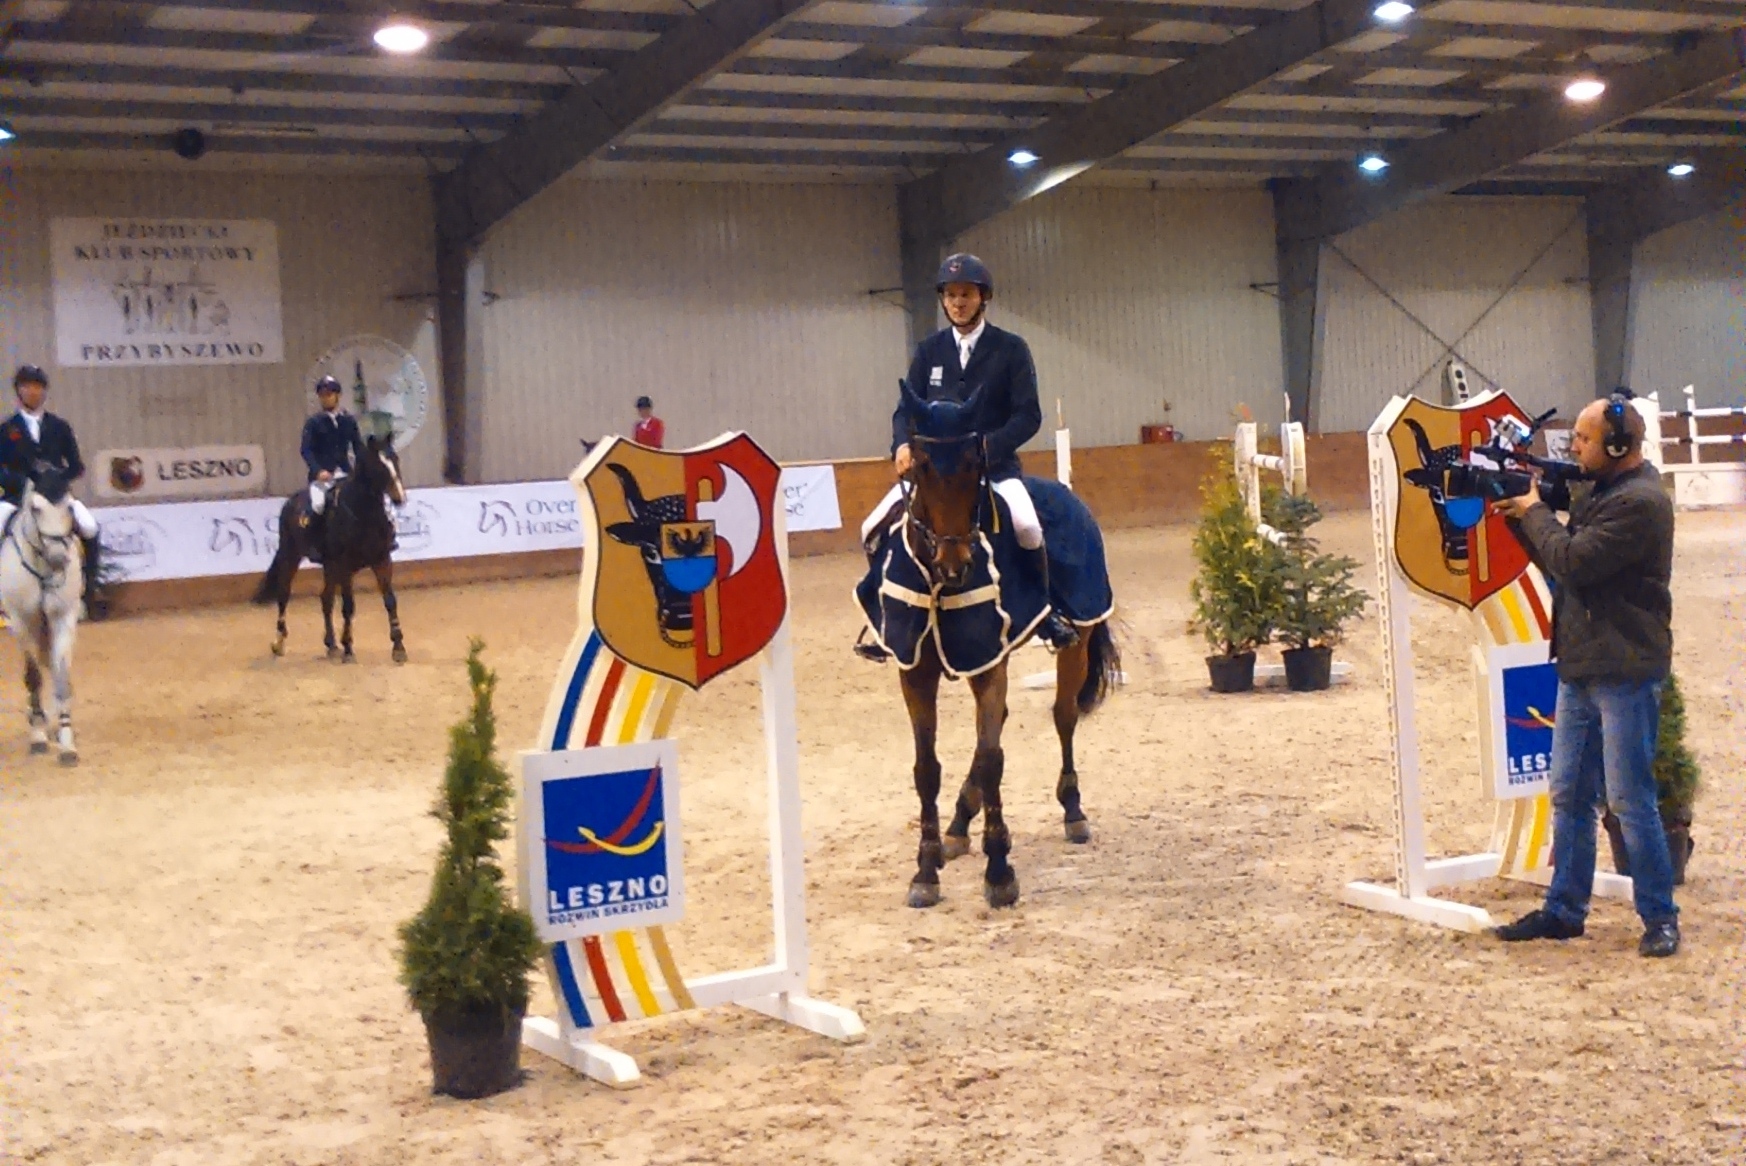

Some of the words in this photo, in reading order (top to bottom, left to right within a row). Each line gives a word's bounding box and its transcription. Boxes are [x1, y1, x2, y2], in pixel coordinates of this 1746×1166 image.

[75, 245, 133, 261] KLUB
[141, 245, 254, 261] SPORTOWY
[82, 343, 264, 361] PRZYBYSZEWO
[157, 458, 252, 481] LESZNO
[784, 482, 807, 499] er
[525, 499, 576, 515] Over
[515, 519, 579, 536] Horse
[1509, 752, 1552, 773] LES
[550, 874, 667, 910] LESZNO
